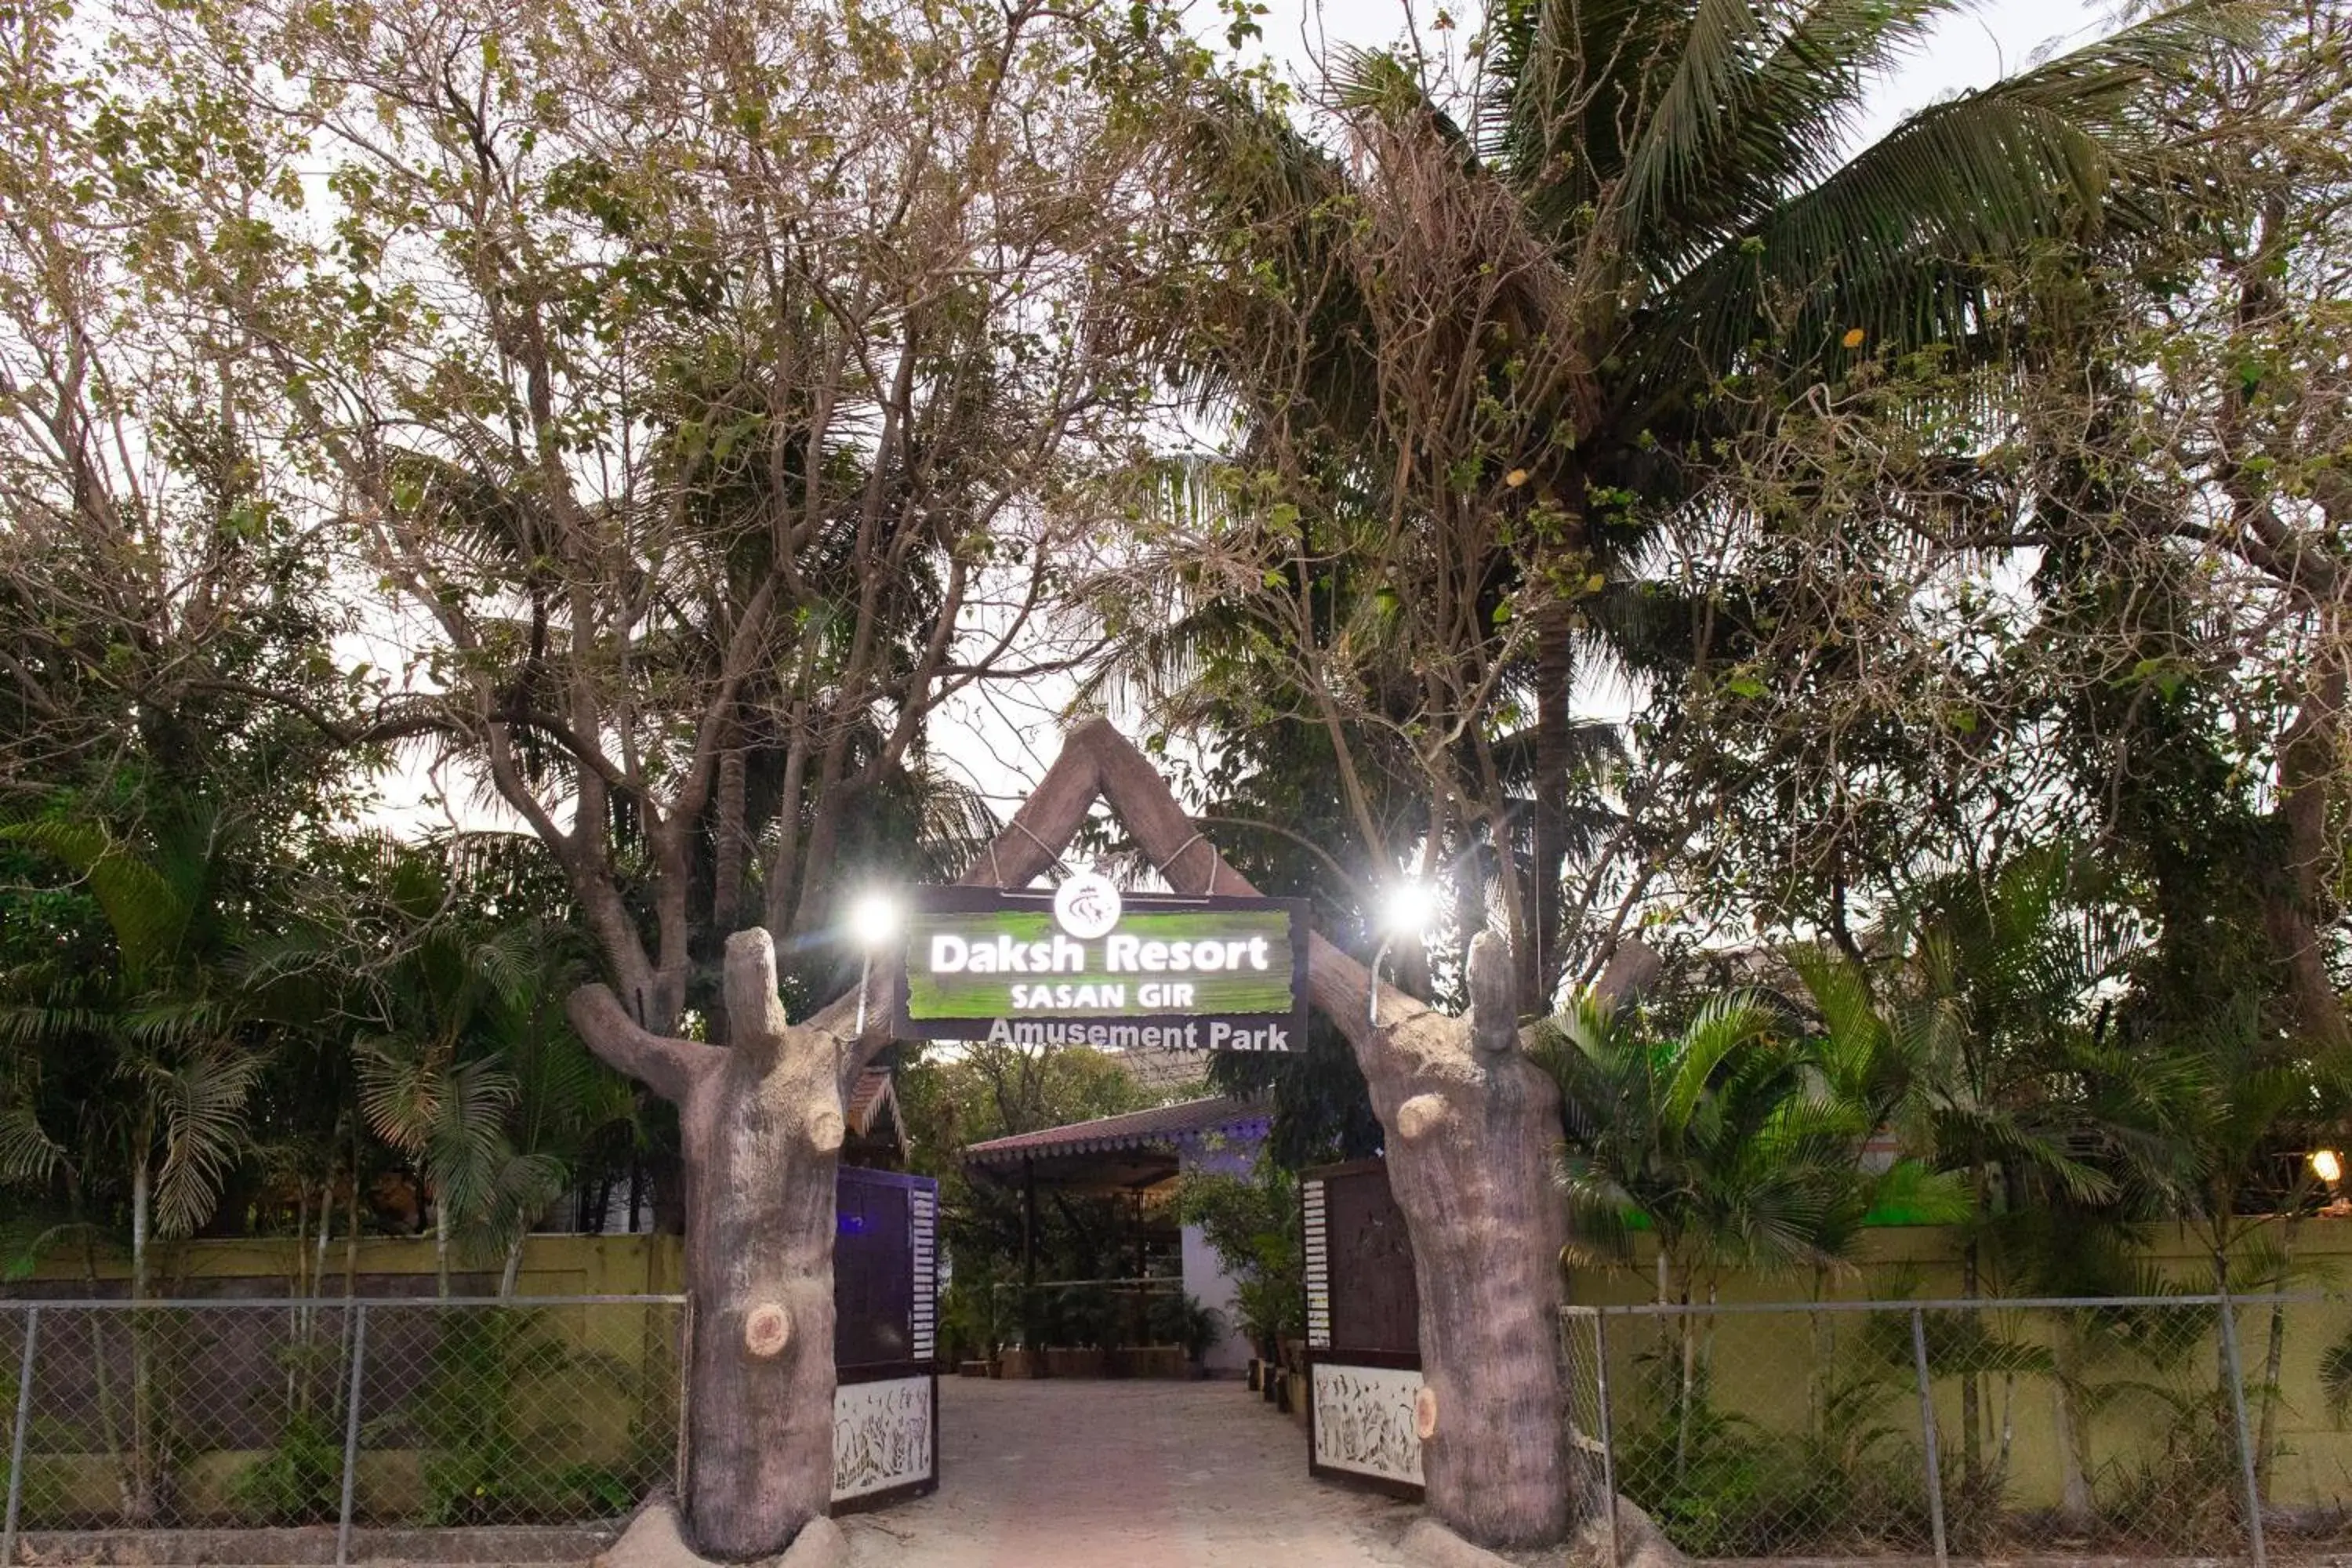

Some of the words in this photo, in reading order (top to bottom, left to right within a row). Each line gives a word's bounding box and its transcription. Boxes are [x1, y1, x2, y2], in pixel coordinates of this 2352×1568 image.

[931, 935, 1084, 972] Daksh
[1106, 935, 1269, 971] Resort
[1011, 984, 1123, 1009] SASAN
[1138, 983, 1194, 1007] GIR
[988, 1019, 1197, 1048] Amusement
[1210, 1022, 1288, 1051] Park
